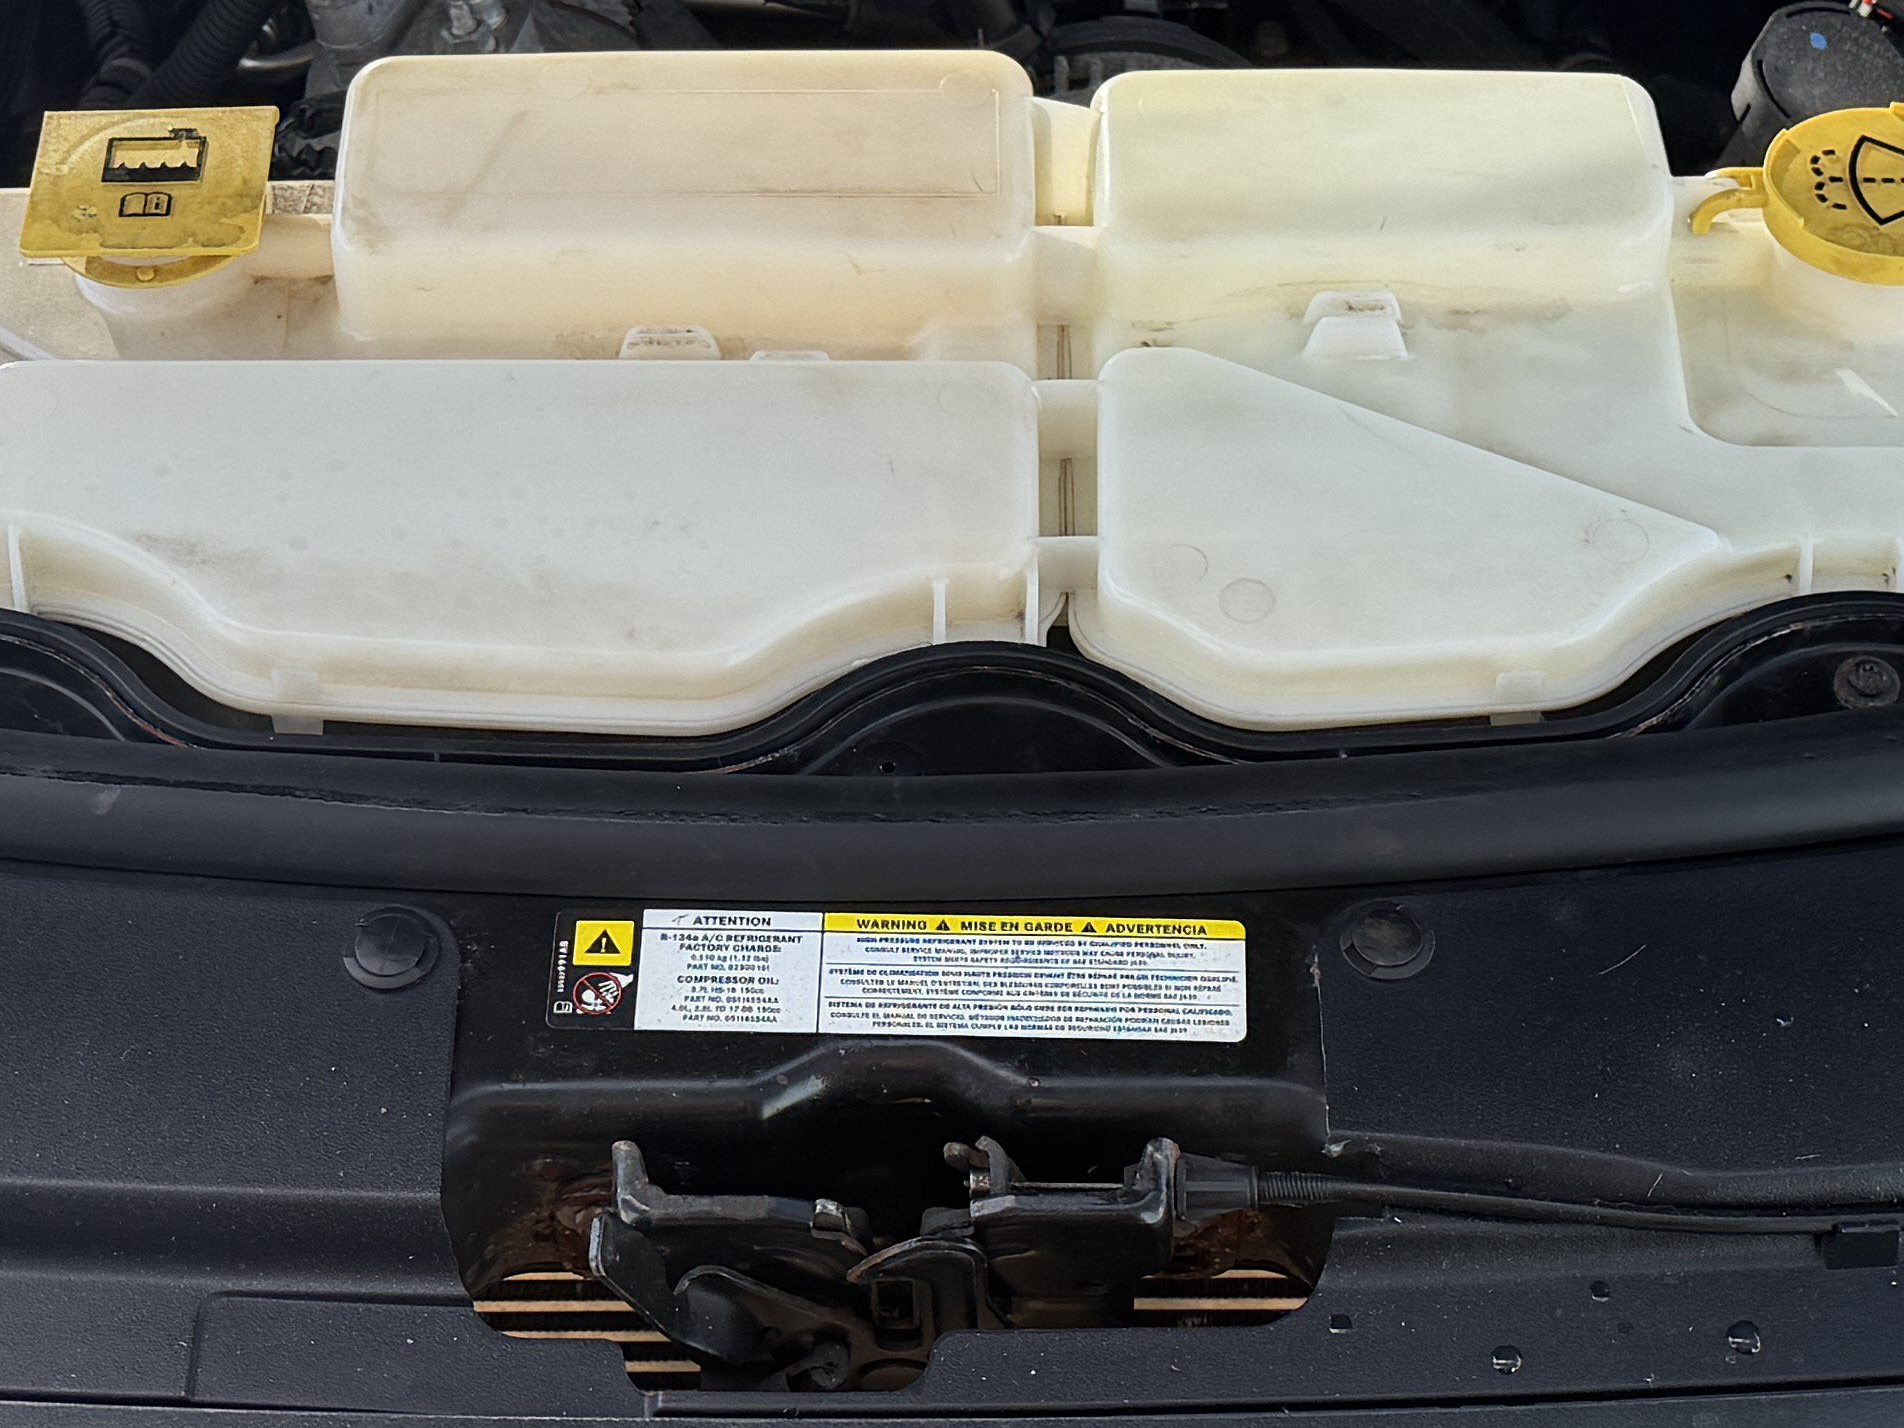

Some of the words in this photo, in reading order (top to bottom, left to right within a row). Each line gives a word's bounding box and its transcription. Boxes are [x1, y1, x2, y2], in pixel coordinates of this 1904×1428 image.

[693, 916, 771, 927] ATTENTION
[856, 919, 927, 931] WARNING
[961, 921, 996, 931] MISE
[1001, 922, 1019, 932] EN
[1024, 922, 1073, 932] GARDE
[1105, 923, 1207, 936] ADVERTENCIA
[725, 934, 803, 944] REFRIGERANT
[679, 943, 729, 952] FACTORY
[732, 945, 782, 953] CHARGE:
[677, 975, 755, 984] COMPRESSOR
[758, 977, 779, 985] OIL:
